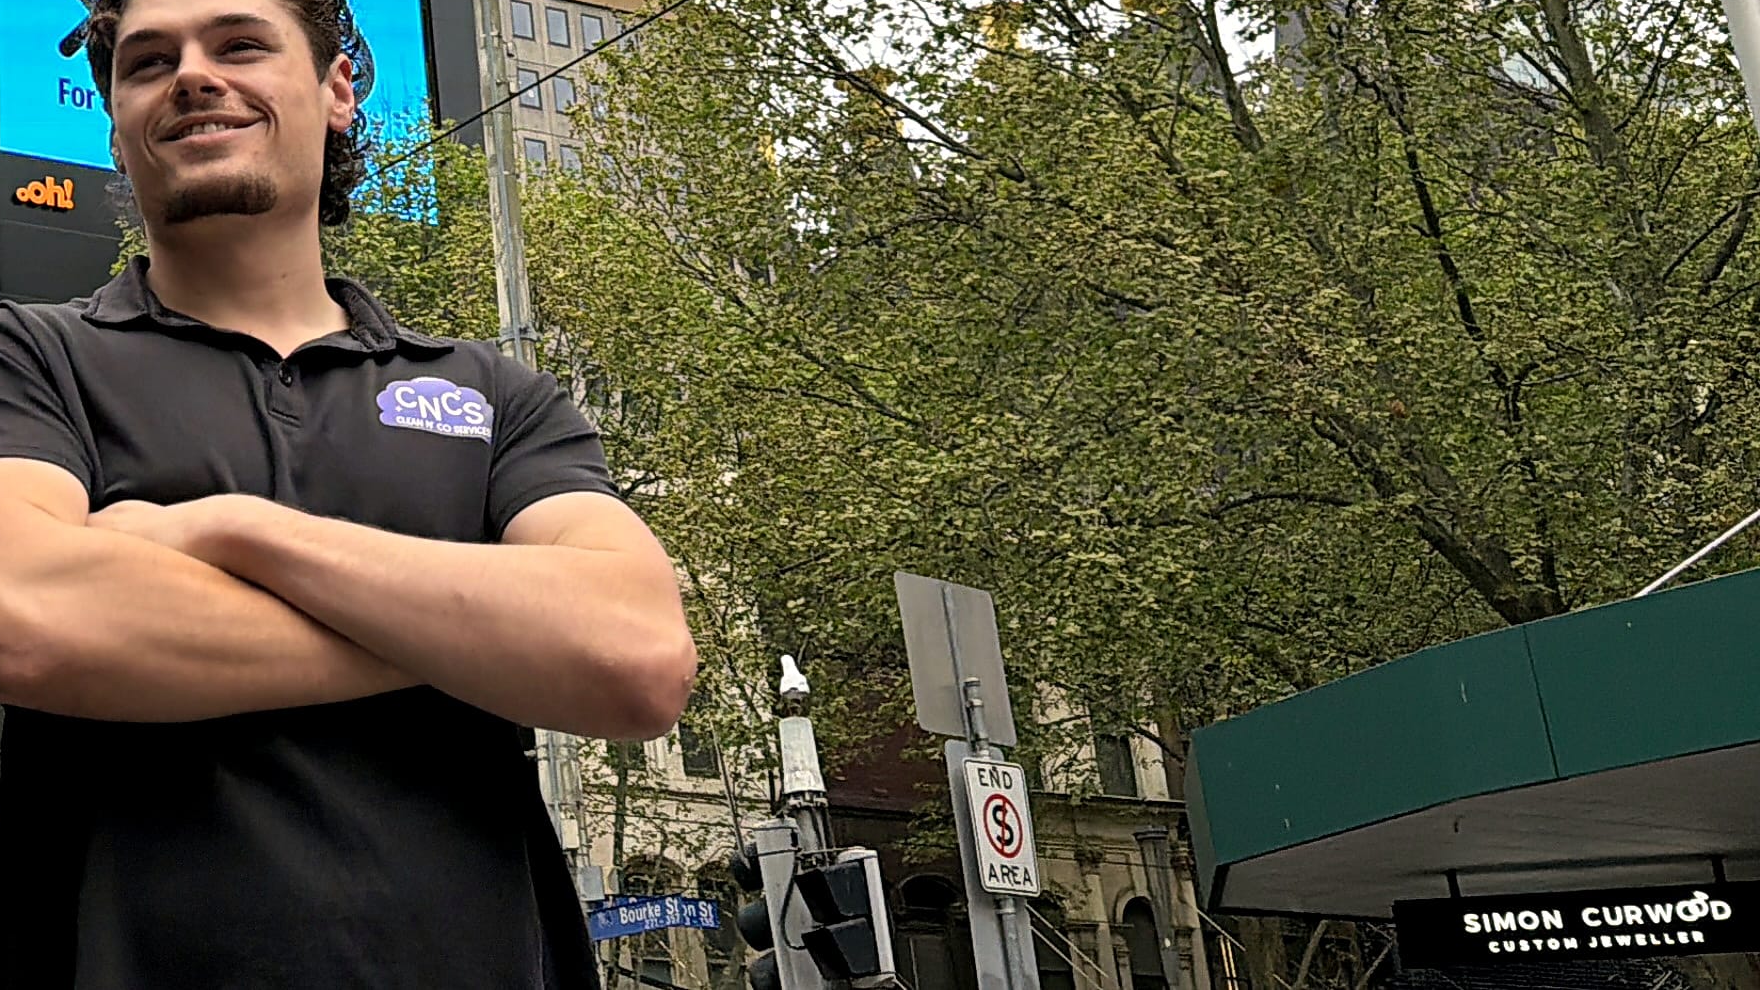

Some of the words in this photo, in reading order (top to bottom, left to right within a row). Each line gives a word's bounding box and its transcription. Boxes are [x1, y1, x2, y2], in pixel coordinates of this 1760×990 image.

[59, 77, 96, 110] For
[395, 387, 484, 425] CNCS
[395, 415, 424, 428] CLEAN
[436, 422, 452, 433] CO
[977, 767, 1013, 790] END
[988, 862, 1033, 887] AREA
[619, 901, 661, 925] Bourke
[665, 896, 679, 915] St
[698, 900, 713, 918] St
[1463, 910, 1563, 934] SIMON
[1581, 890, 1732, 927] CURWOOD
[1488, 938, 1578, 953] CUSTOM
[1589, 931, 1705, 948] JEWELLER
